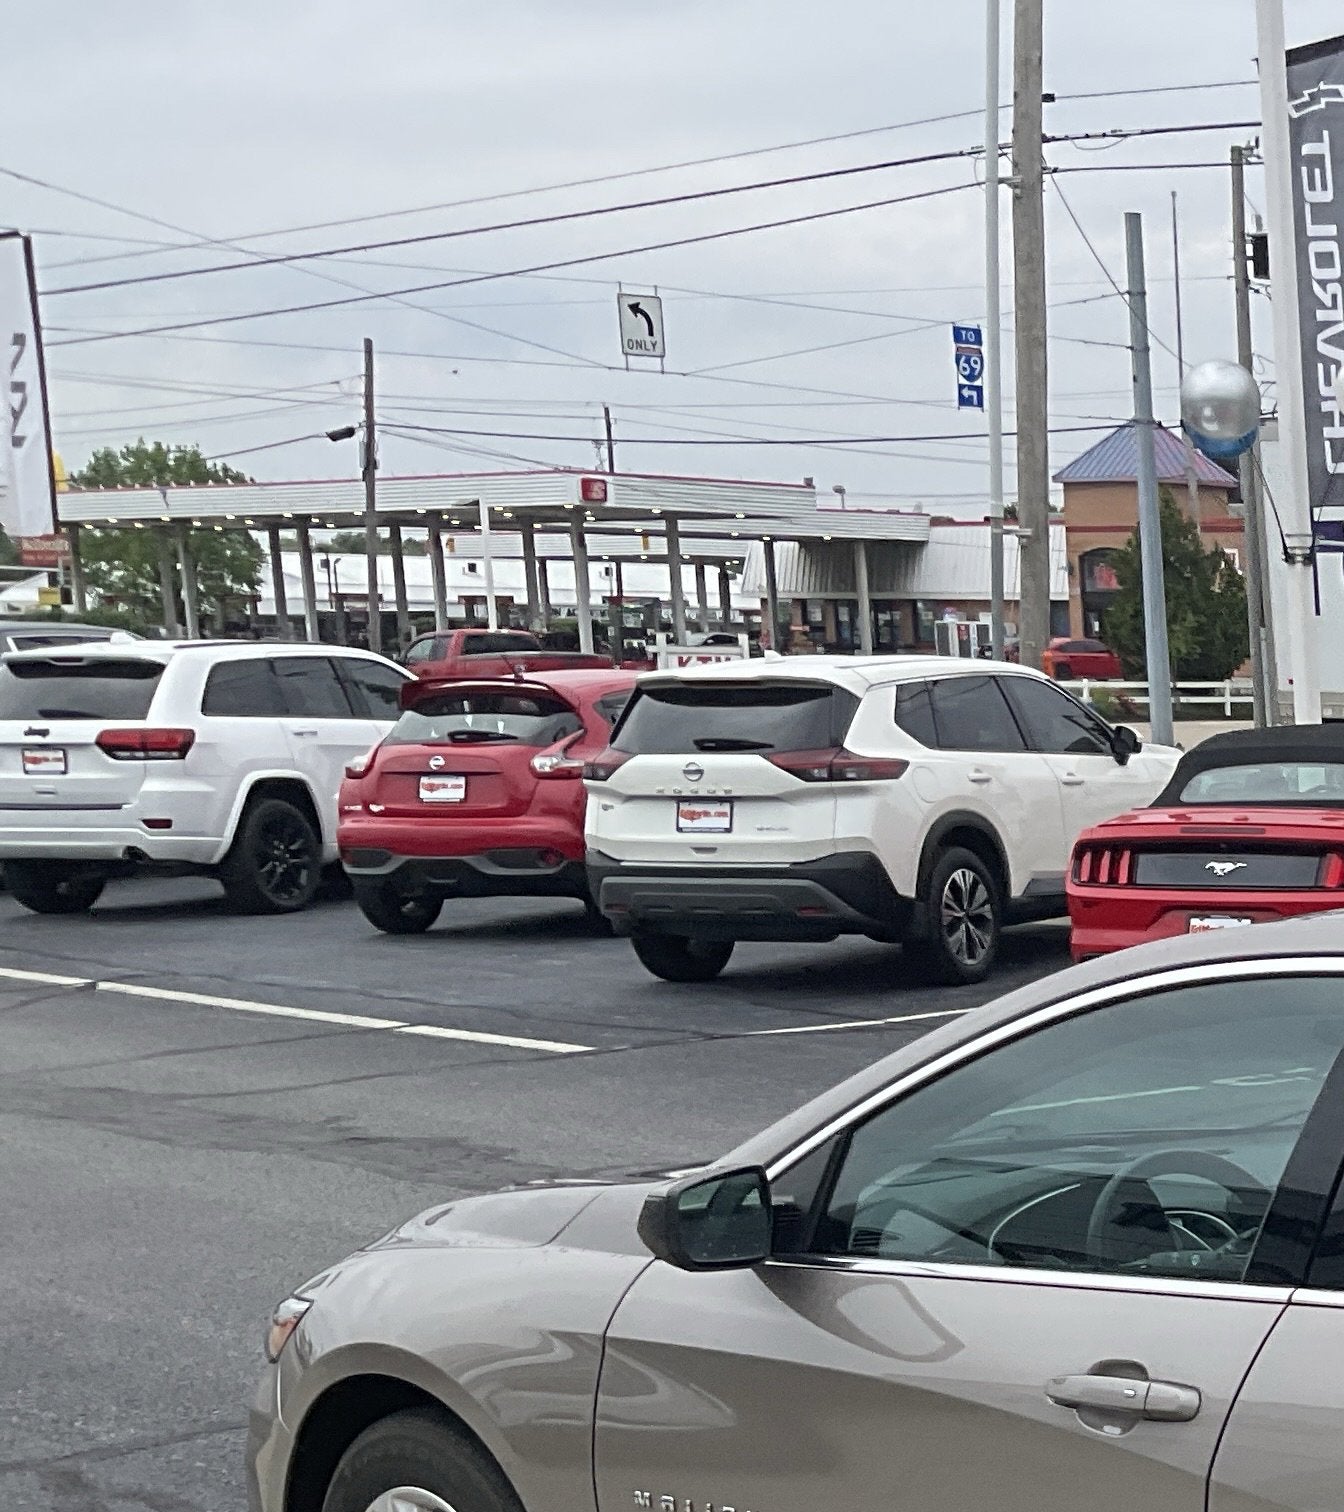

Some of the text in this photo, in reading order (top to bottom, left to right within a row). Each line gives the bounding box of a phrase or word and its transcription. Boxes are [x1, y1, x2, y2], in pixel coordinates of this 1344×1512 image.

[961, 330, 975, 342] TO
[627, 338, 657, 352] ONLY
[960, 355, 981, 376] 69
